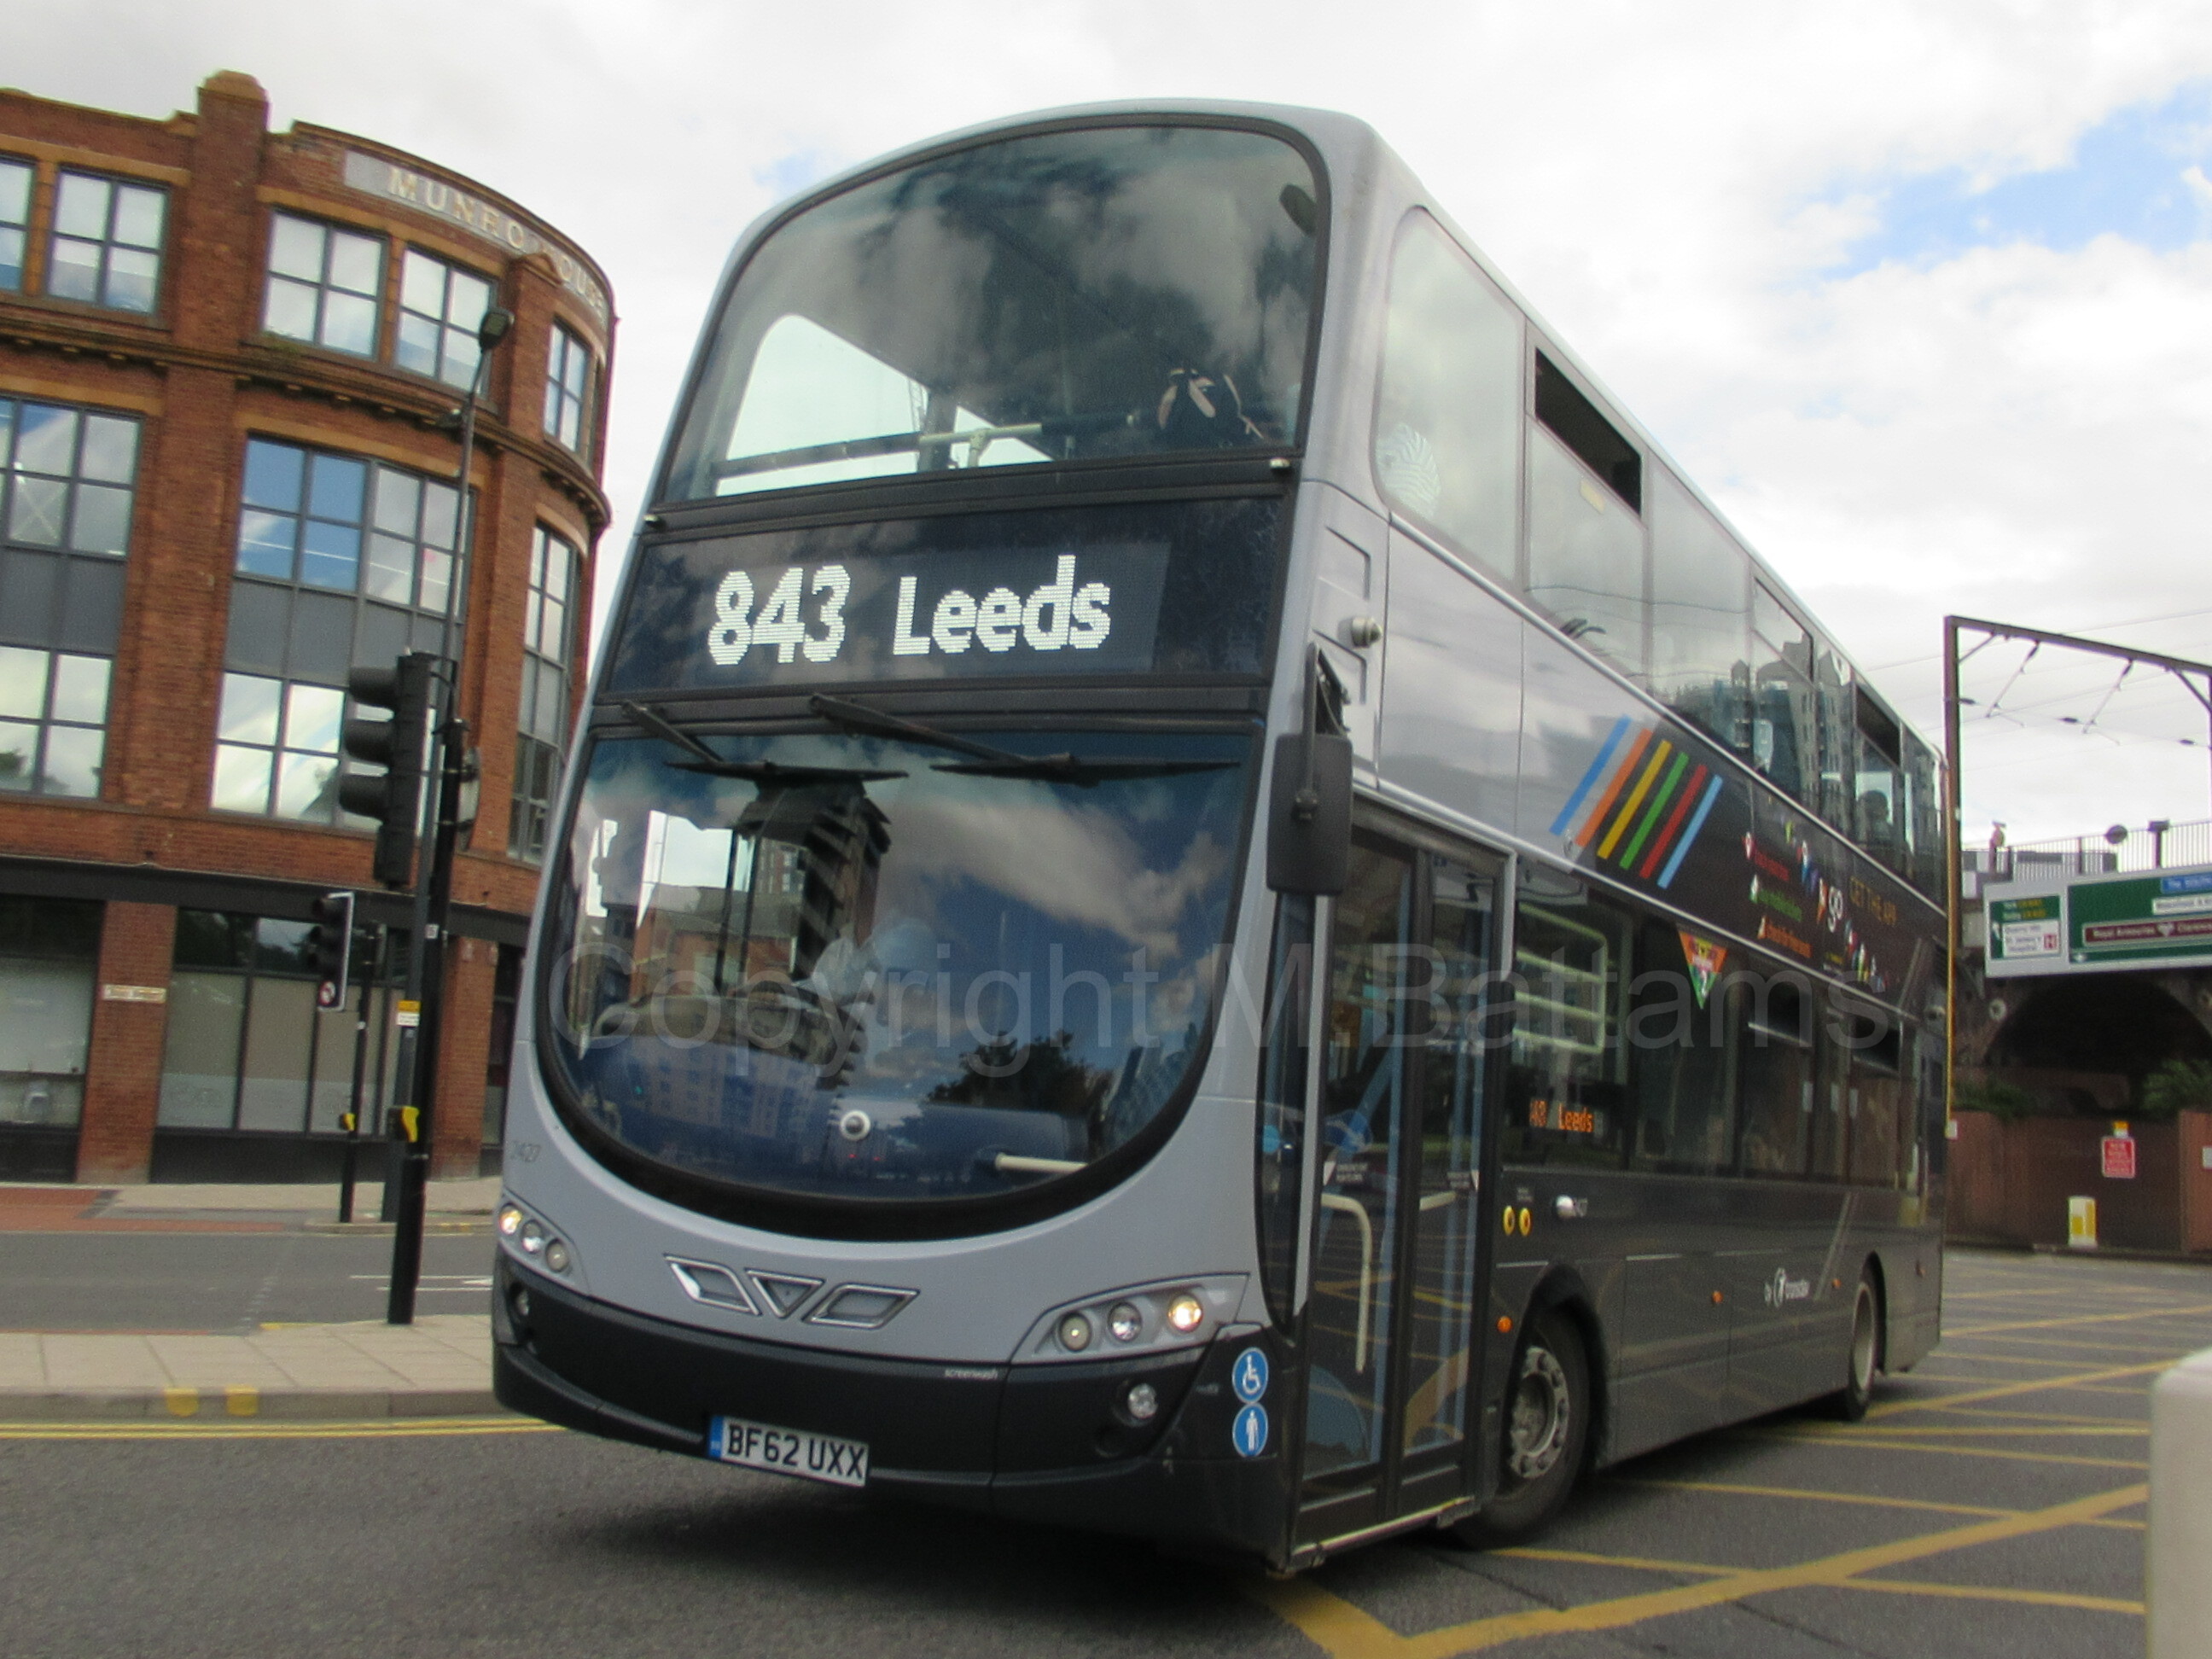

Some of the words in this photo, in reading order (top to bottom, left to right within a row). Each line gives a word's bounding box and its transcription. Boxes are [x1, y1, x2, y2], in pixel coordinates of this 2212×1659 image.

[707, 564, 851, 666] 843
[893, 554, 1111, 655] Leeds
[727, 1423, 800, 1467] BF62
[807, 1438, 865, 1480] UXX
